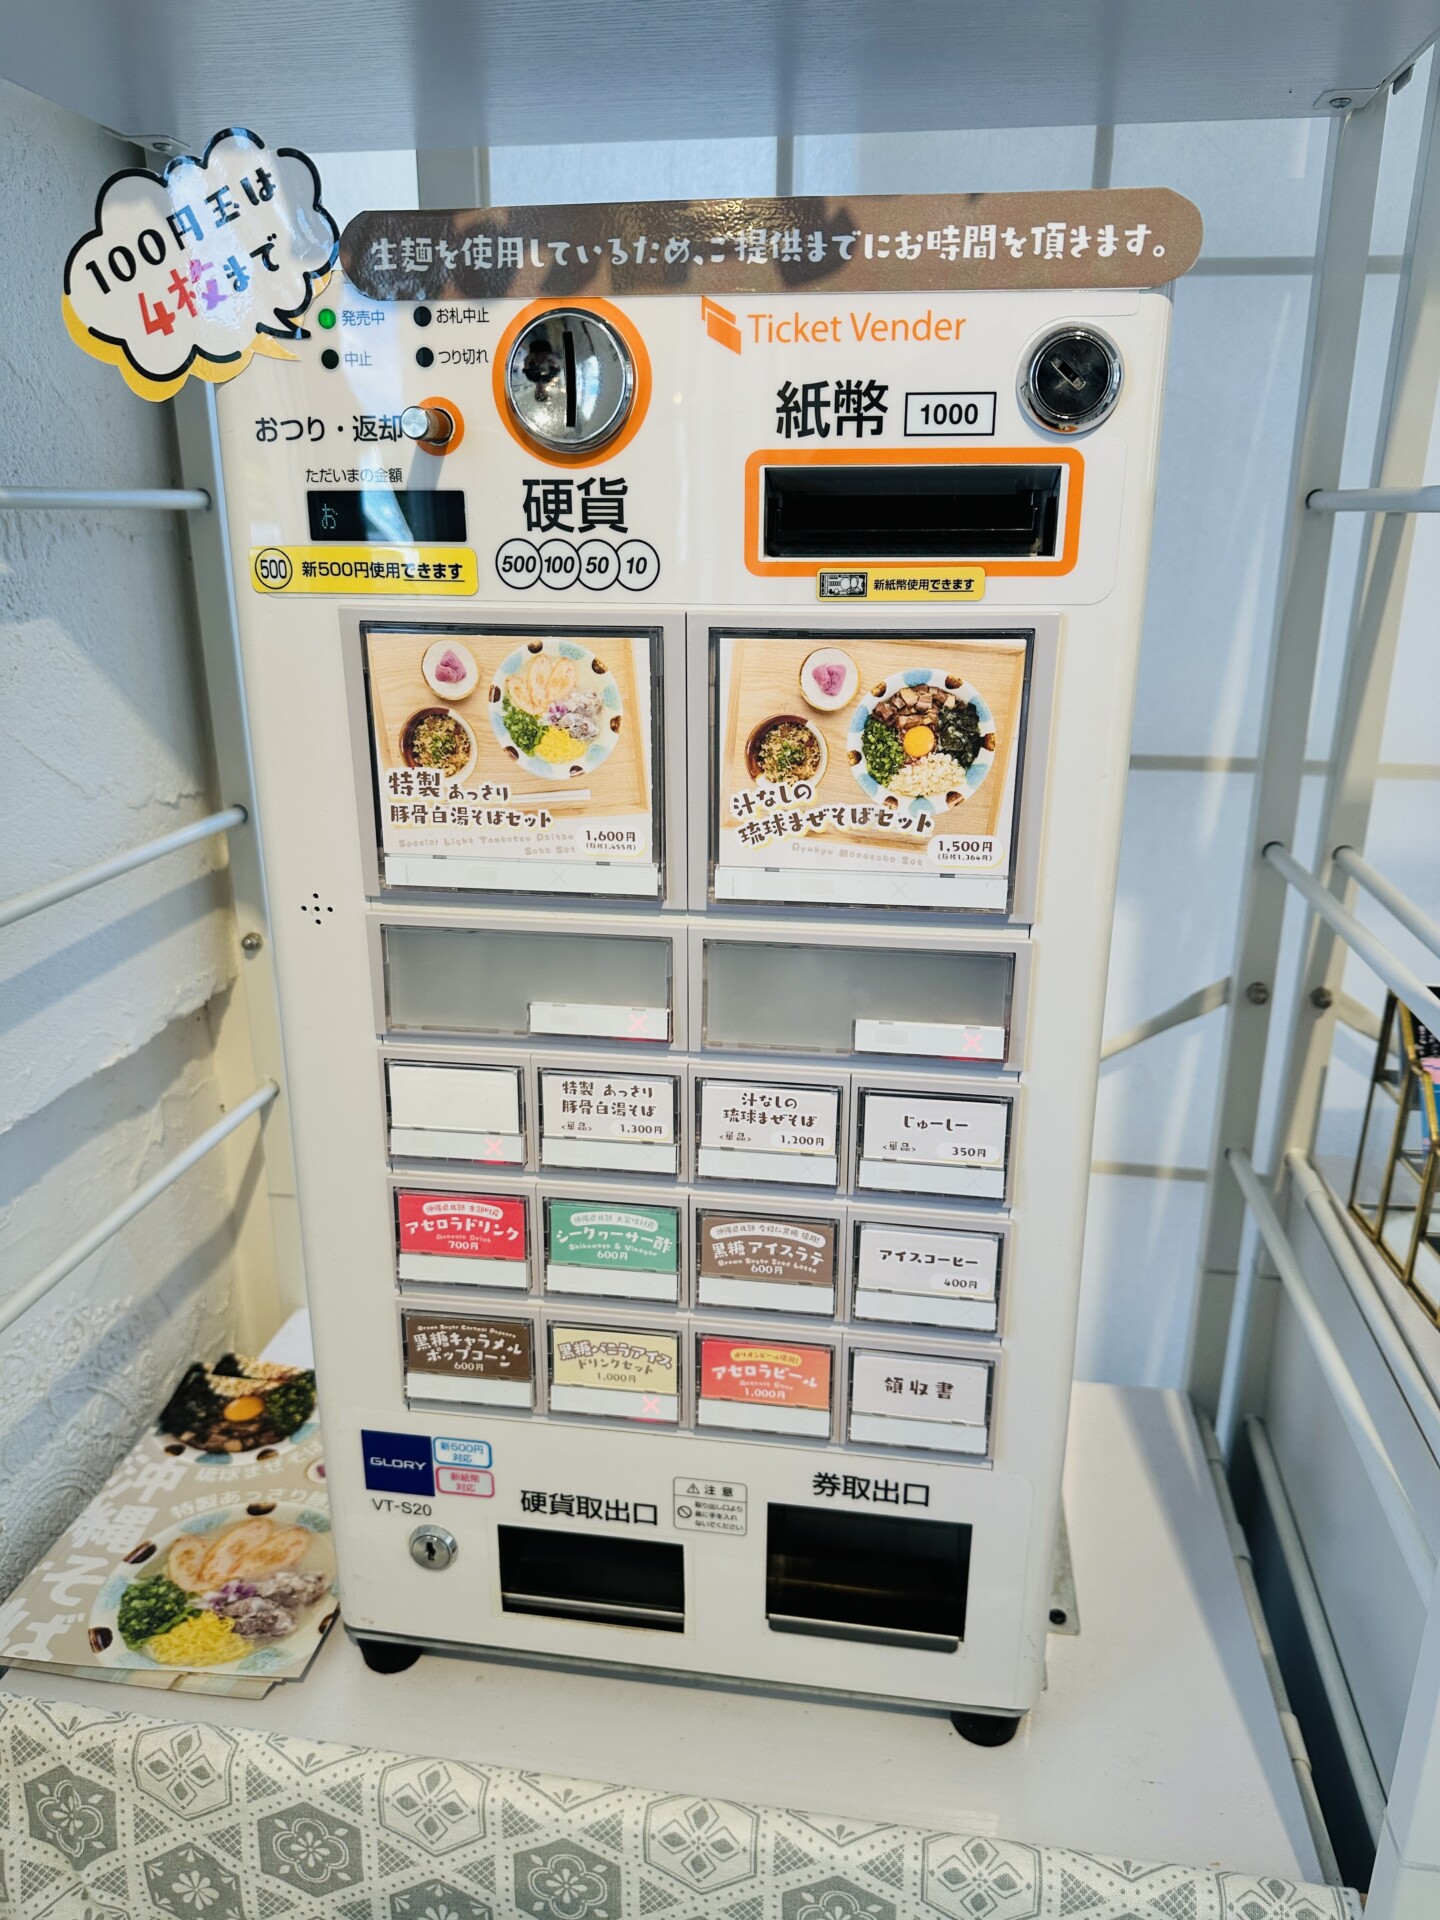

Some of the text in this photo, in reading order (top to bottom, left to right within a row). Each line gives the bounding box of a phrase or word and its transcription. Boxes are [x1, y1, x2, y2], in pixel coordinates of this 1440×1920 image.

[86, 167, 276, 294] 100円玉は
[138, 233, 280, 336] 4枚まで
[342, 310, 385, 326] 発売中
[436, 307, 490, 324] お札中止
[747, 310, 967, 343] Ticket Vender
[345, 351, 372, 367] 中止
[438, 349, 488, 364] つり切れ
[776, 379, 889, 439] 紙幣
[920, 403, 979, 425] 1000
[255, 415, 403, 442] おつり・返却
[306, 468, 403, 483] ただいまの金額
[522, 477, 629, 534] 硬貨
[321, 503, 338, 530] お
[260, 560, 287, 580] 500
[302, 561, 463, 580] 新500円使用できます
[501, 555, 647, 574] 500 100 50 10
[873, 579, 975, 592] 新紙幣使用できます
[389, 771, 509, 802] 特製 あっさり
[733, 783, 813, 816] 汁なしの
[391, 805, 552, 828] 豚骨白湯そばセット
[738, 806, 932, 845] 琉球まぜそばセット
[562, 1081, 653, 1098] 特製 あっさり
[562, 1099, 657, 1118] 豚骨白湯そば
[741, 1092, 797, 1109] 汁なしの
[723, 1108, 818, 1127] 琉球まぜそば
[903, 1114, 969, 1132] じゅーしー
[951, 1146, 987, 1158] 350円
[405, 1216, 519, 1241] アセロラドリンク
[448, 1240, 479, 1251] 700円
[597, 1250, 628, 1260] 600円
[712, 1240, 824, 1265] 黒糖アイスラテ
[880, 1249, 978, 1267] アイスコーヒー
[751, 1264, 783, 1275] 600円
[944, 1278, 978, 1289] 400円
[413, 1330, 522, 1355] 黒糖キャラメル
[427, 1345, 511, 1367] ポップコーン
[454, 1361, 484, 1372] 600円
[578, 1358, 653, 1374] ドリンクセット
[712, 1364, 817, 1388] アセロラビール
[884, 1377, 954, 1399] 領収書
[440, 1441, 484, 1455] 新500円
[370, 1456, 427, 1471] GLORY
[452, 1453, 473, 1463] 対応
[456, 1482, 476, 1493] 対応
[704, 1484, 734, 1497] 注意
[813, 1471, 930, 1507] 券取出口
[372, 1498, 432, 1516] VT-S20
[520, 1490, 657, 1526] 硬貨取出口
